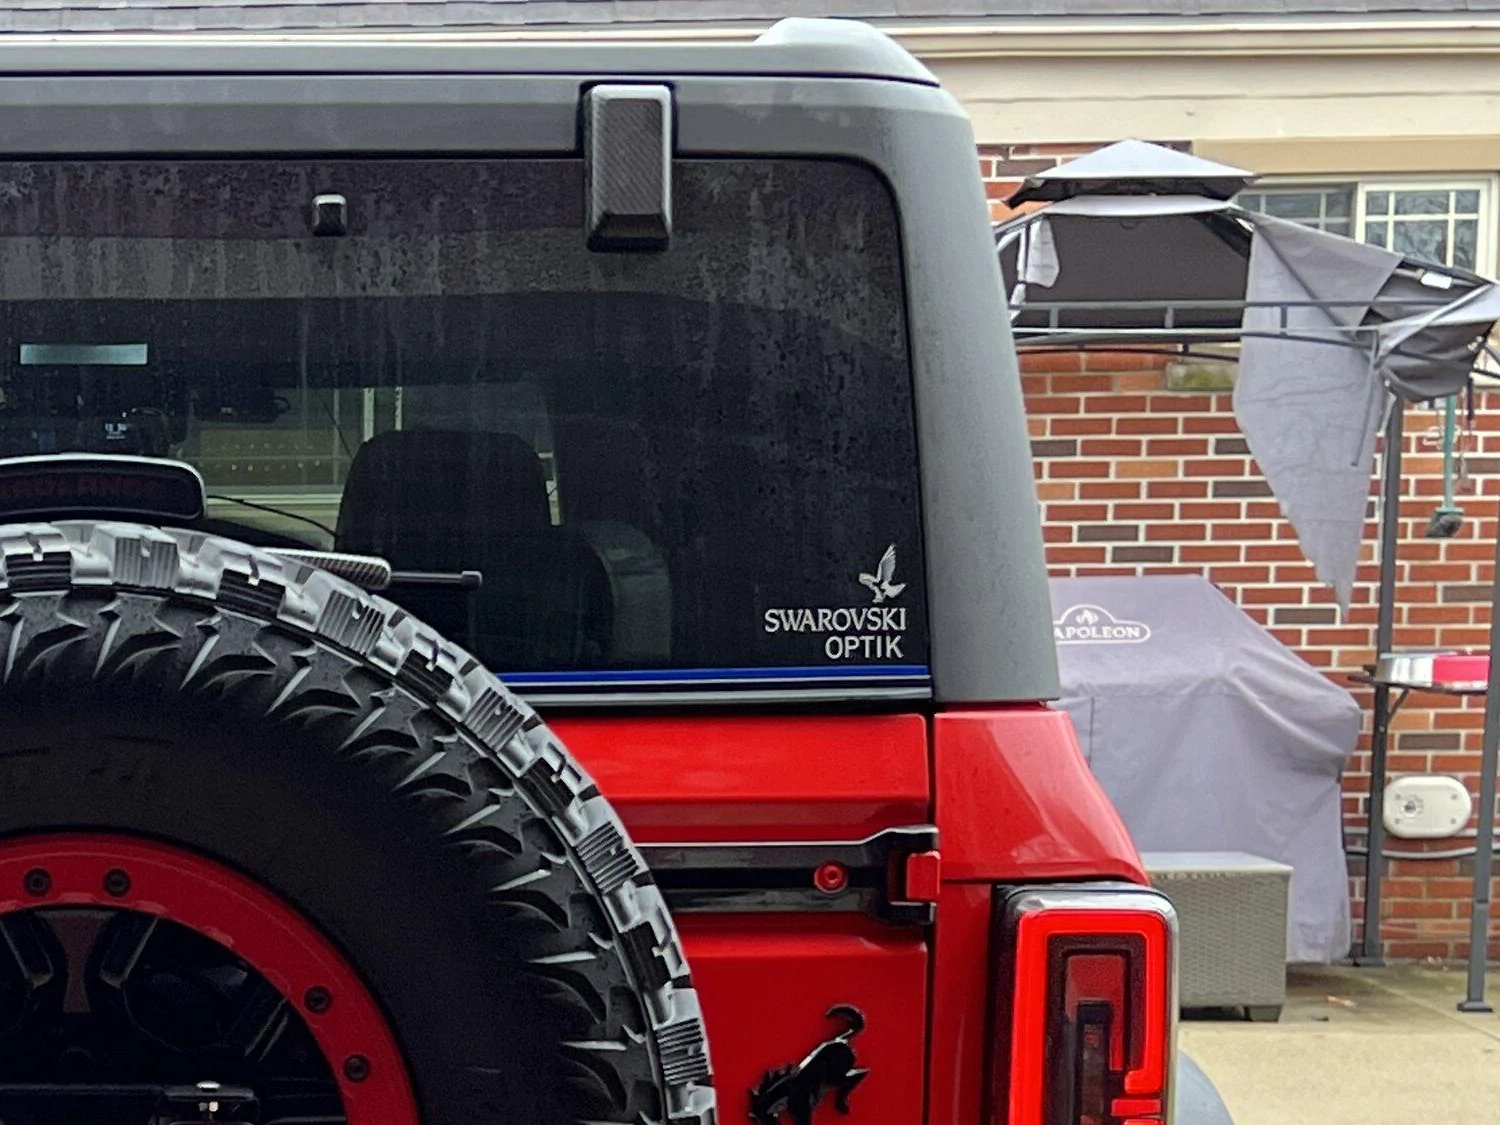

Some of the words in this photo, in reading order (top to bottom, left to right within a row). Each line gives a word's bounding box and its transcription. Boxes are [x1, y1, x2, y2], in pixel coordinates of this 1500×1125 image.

[764, 607, 906, 633] SWAROVSKI
[1053, 626, 1140, 639] APOLEON
[825, 635, 904, 659] OPTIK
